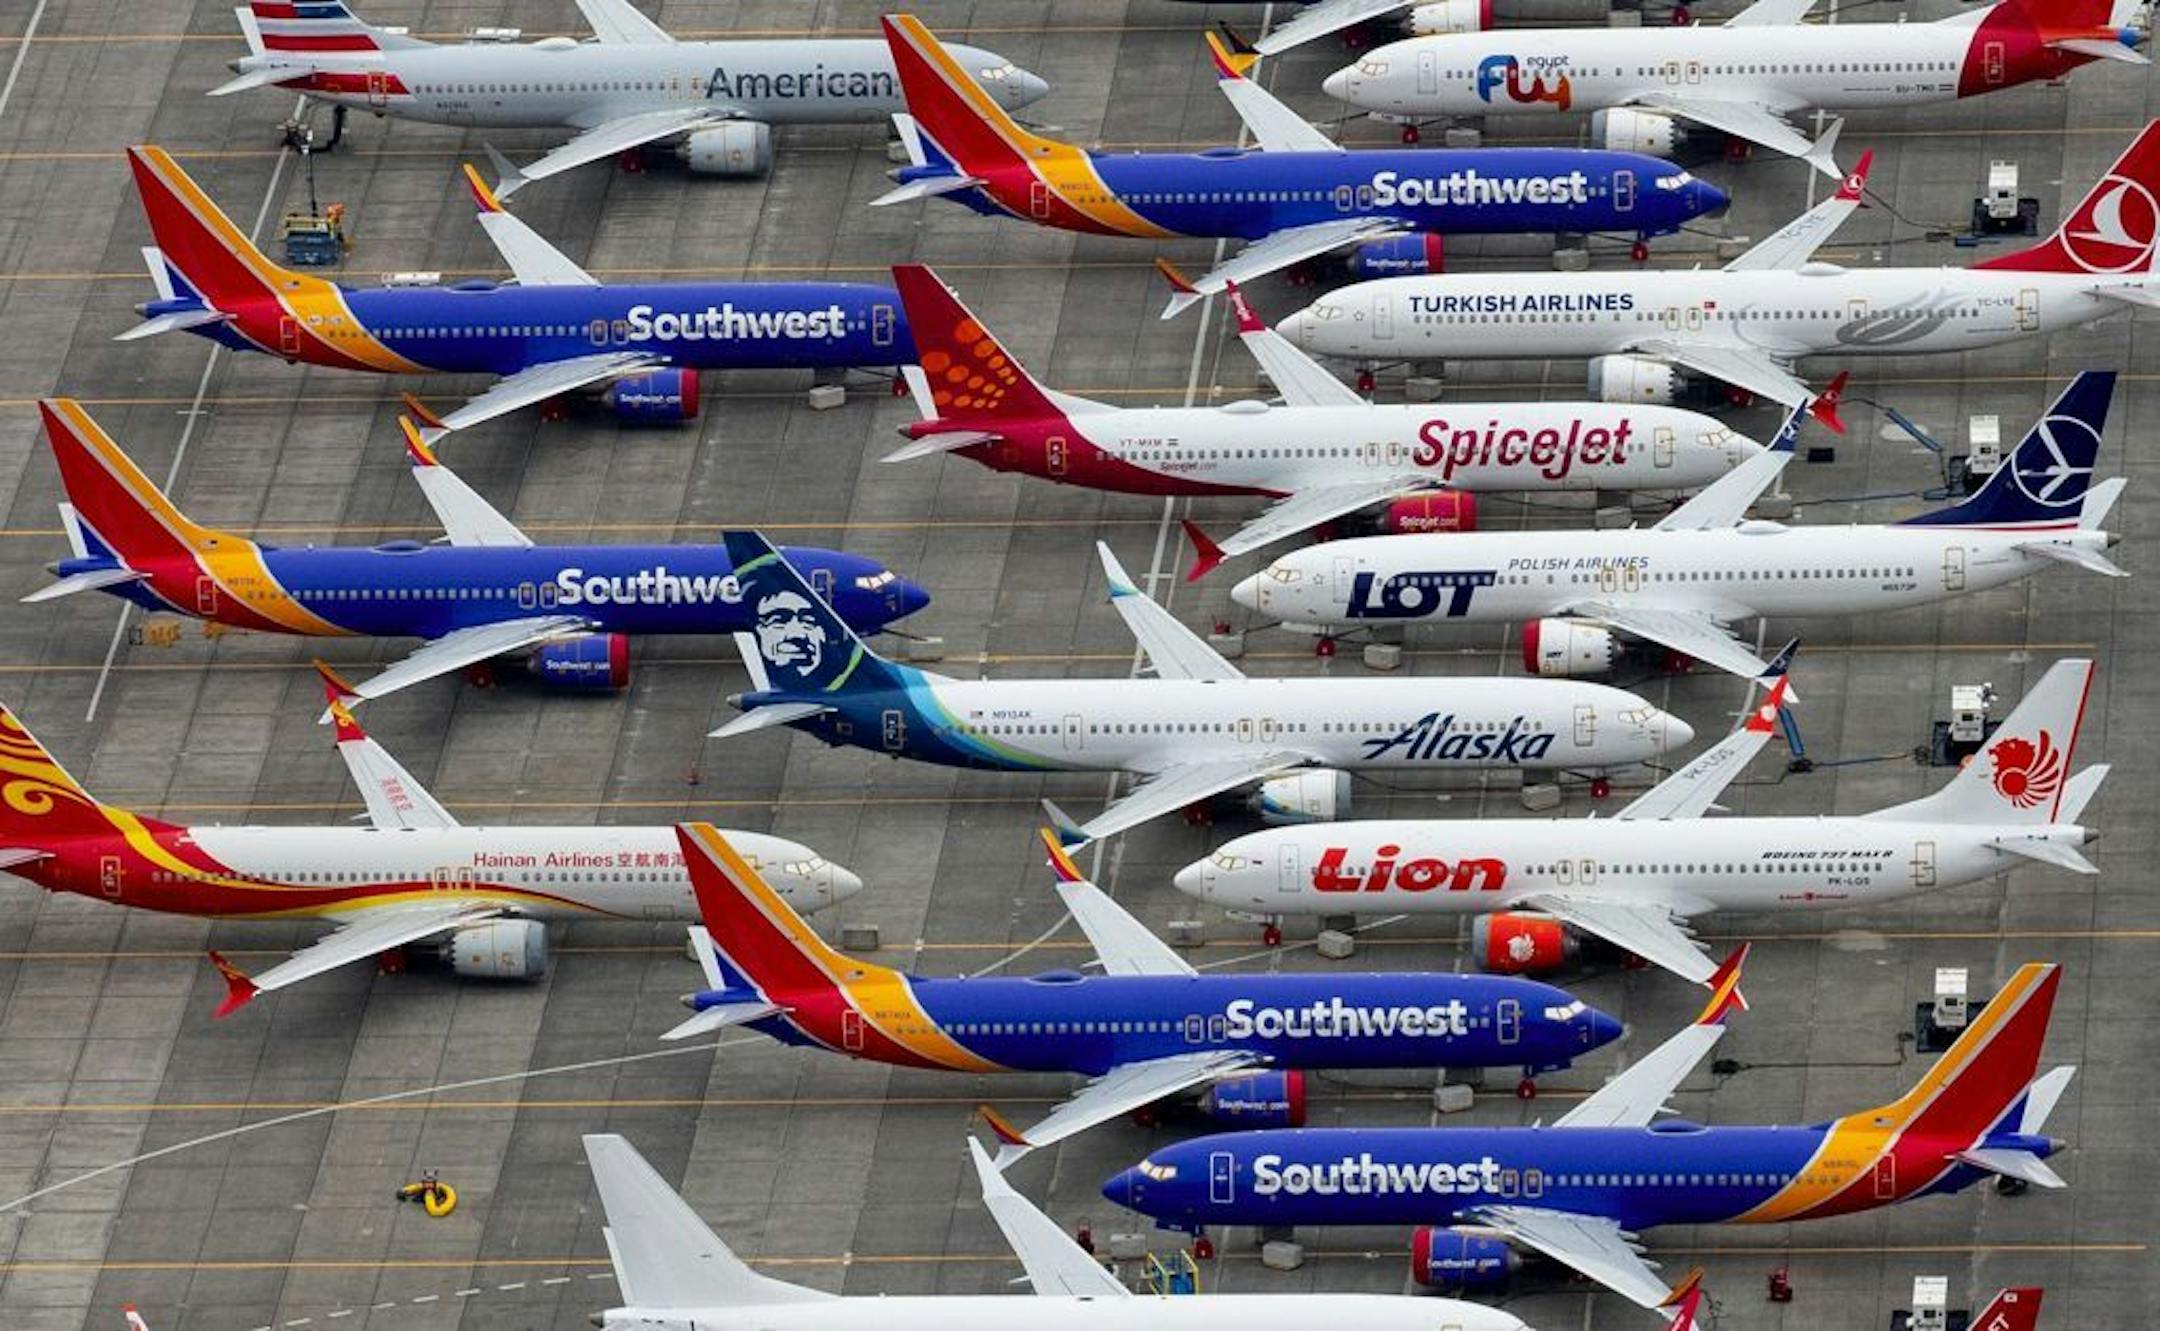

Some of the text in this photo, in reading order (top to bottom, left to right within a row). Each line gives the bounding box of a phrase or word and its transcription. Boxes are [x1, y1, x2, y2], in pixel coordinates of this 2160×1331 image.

[706, 64, 894, 99] American
[1526, 56, 1568, 69] egypt
[1371, 169, 1587, 206] Southwest
[627, 302, 846, 341] Southwest
[1410, 294, 1634, 312] TURKISH AIRLINES
[1413, 419, 1632, 480] SpiceJet
[1508, 556, 1649, 571] POLISH AIRLINES
[557, 566, 743, 605] Southwe
[1346, 570, 1498, 618] LOT
[1362, 712, 1555, 764] Alaska
[474, 852, 614, 868] Hainan Airlines
[1313, 844, 1509, 892] Lion
[1761, 851, 1817, 860] BOEING
[1820, 851, 1849, 859] 737
[1850, 850, 1880, 858] MAX
[1226, 997, 1469, 1039] Southwest
[1253, 1153, 1500, 1194] Southwest
